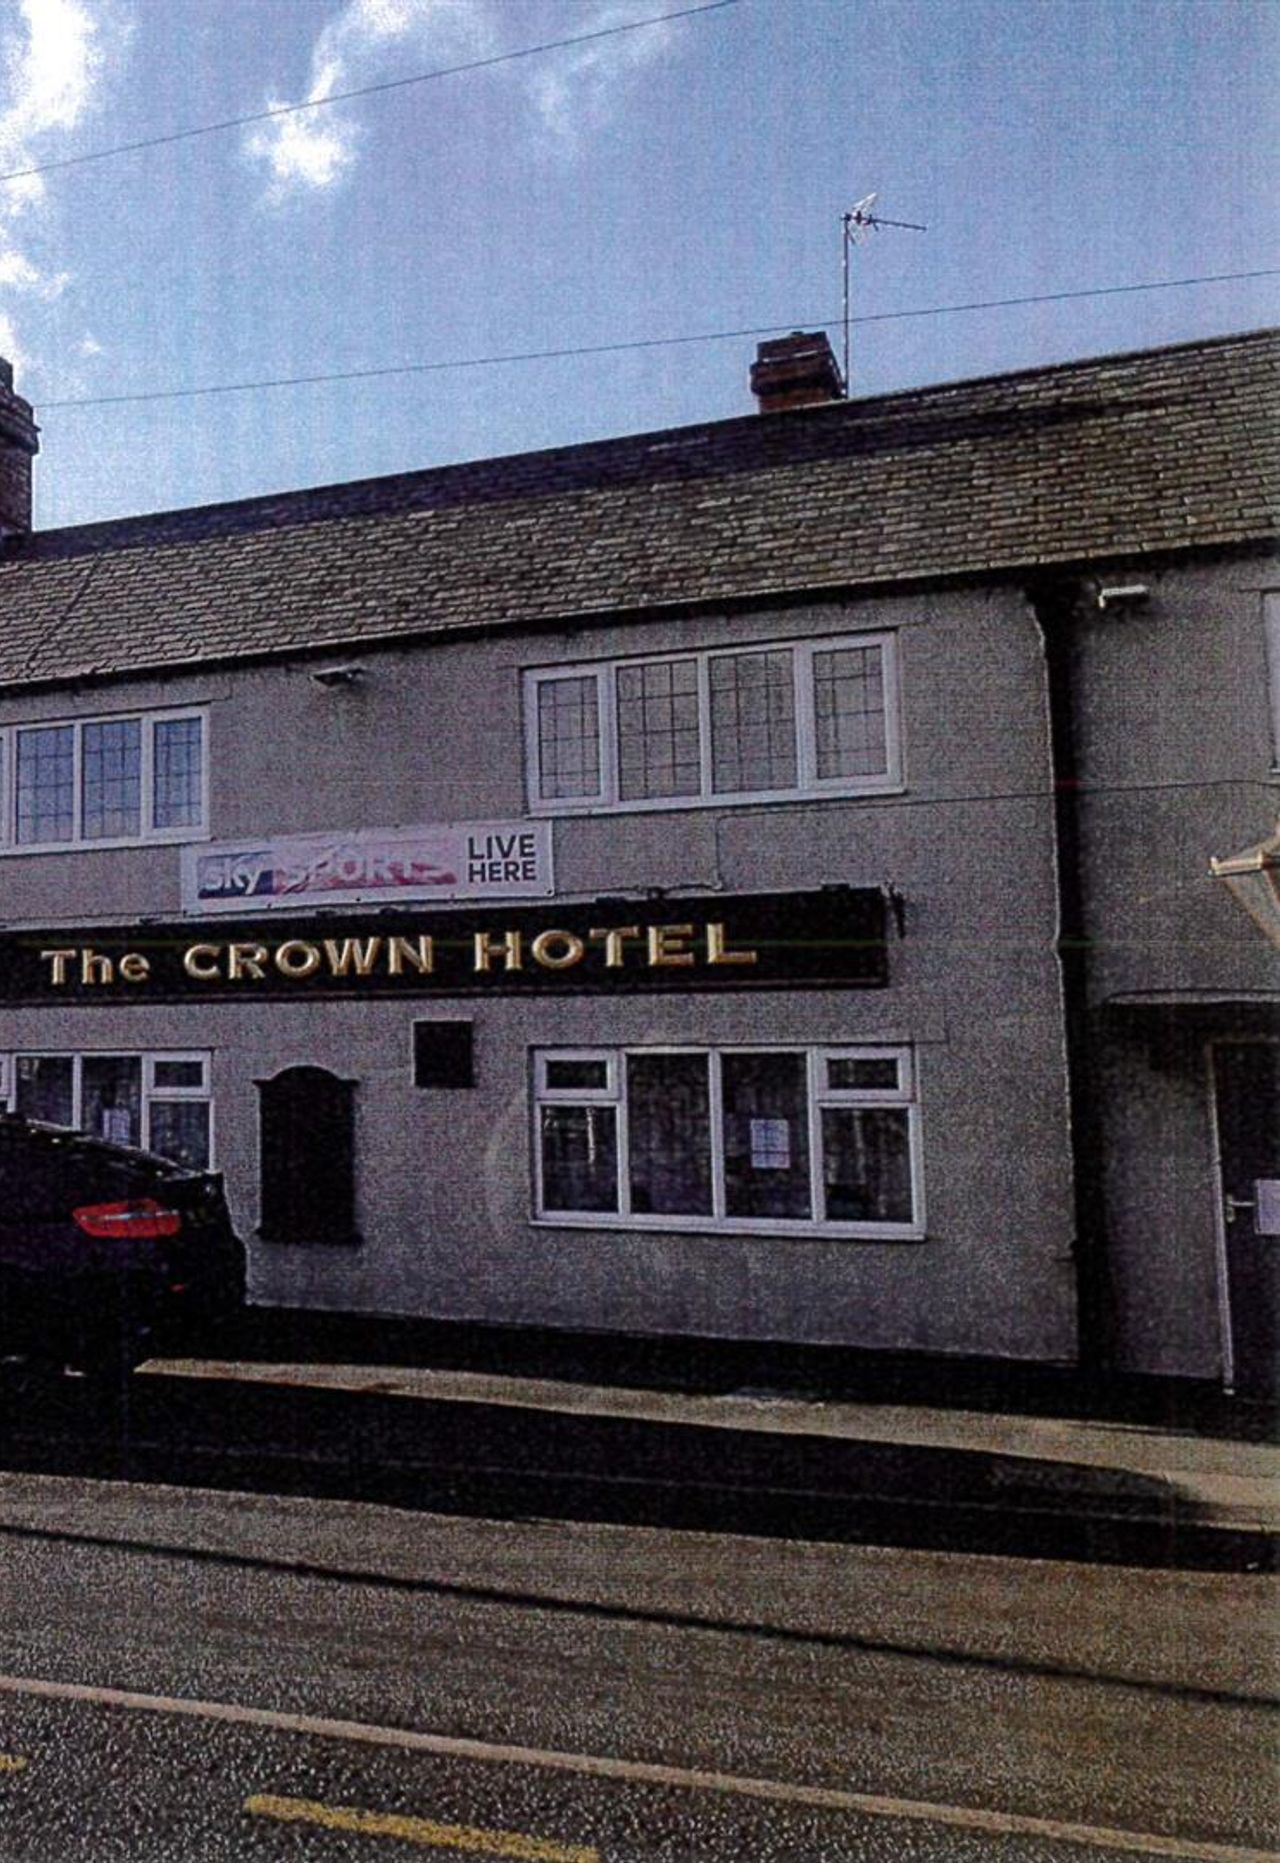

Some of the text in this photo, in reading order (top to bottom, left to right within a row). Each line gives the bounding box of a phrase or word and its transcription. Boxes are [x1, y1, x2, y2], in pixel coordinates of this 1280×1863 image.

[468, 834, 536, 860] LIVE
[204, 853, 263, 895] sky
[468, 861, 537, 883] HERE
[41, 922, 758, 985] The CROWN HOTEL
